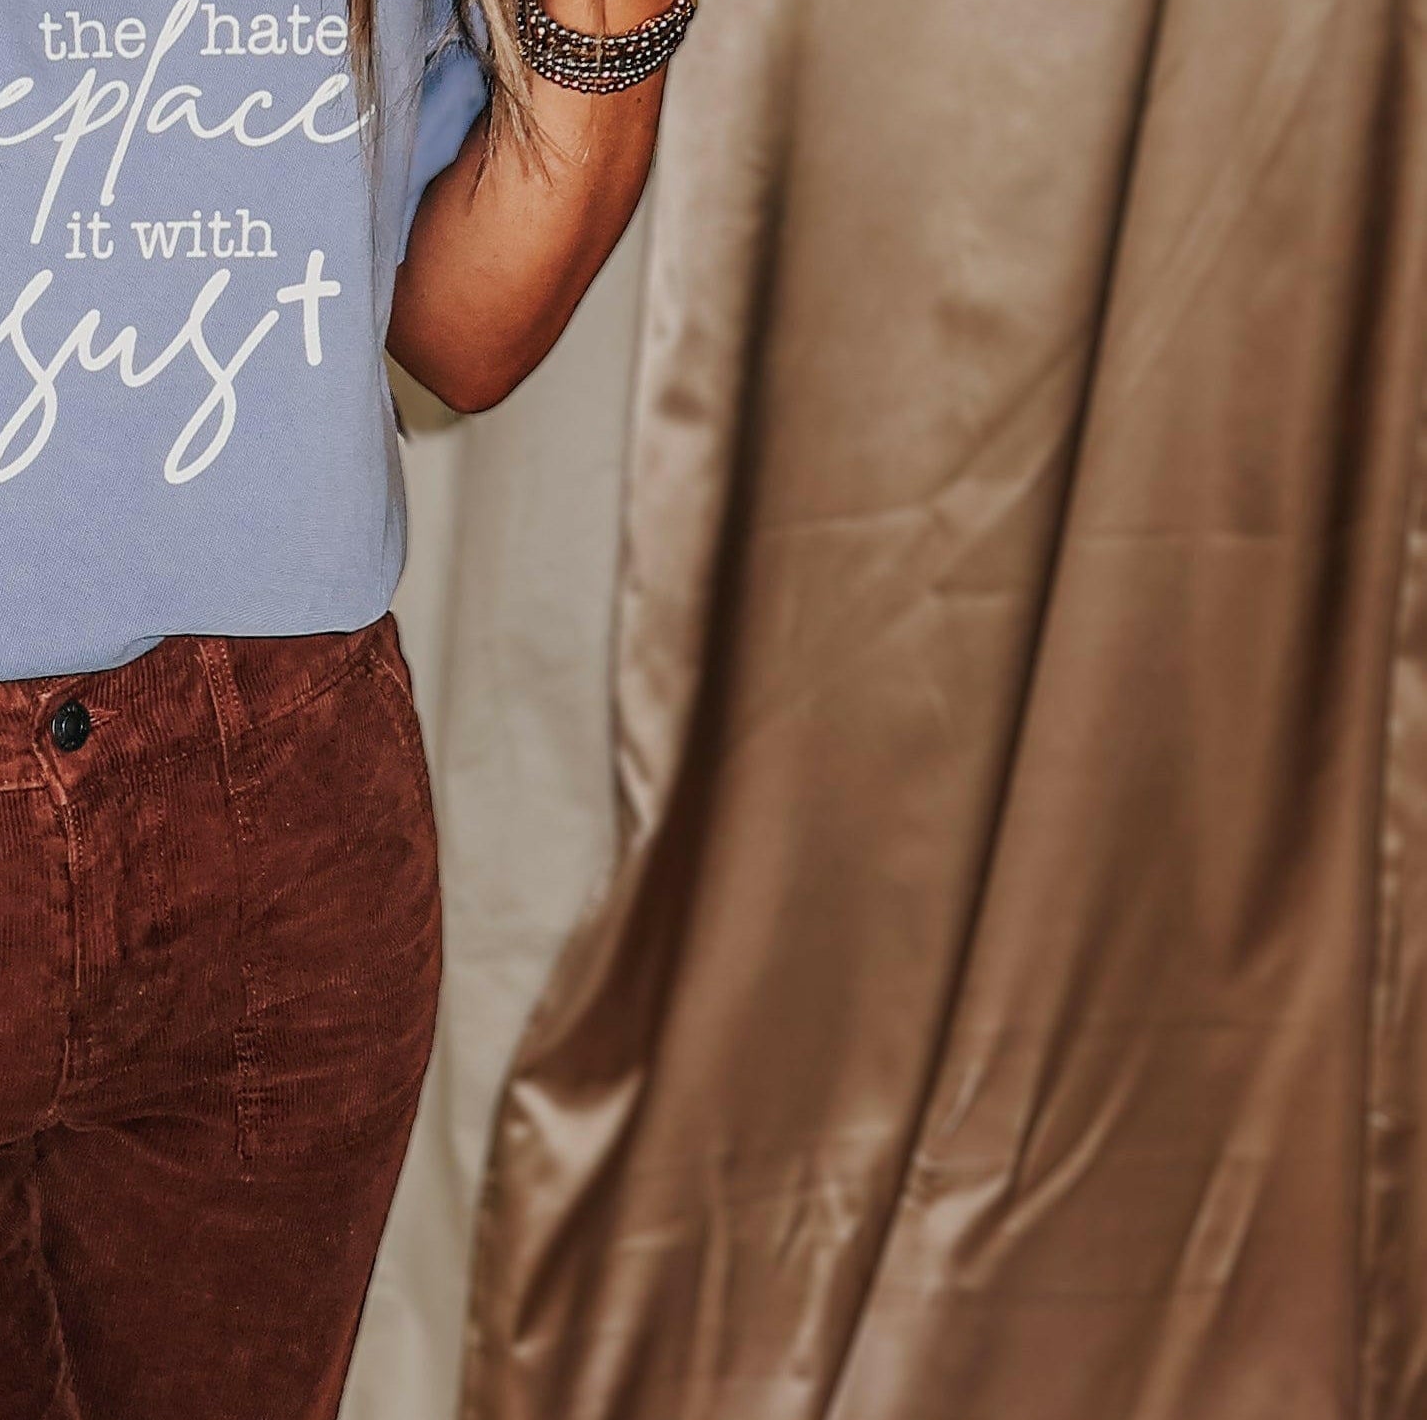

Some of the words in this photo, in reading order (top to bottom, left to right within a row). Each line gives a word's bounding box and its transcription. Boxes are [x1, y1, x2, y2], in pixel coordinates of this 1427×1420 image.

[38, 11, 147, 61] the
[199, 2, 350, 57] hate
[65, 211, 114, 260] it
[130, 208, 278, 260] with
